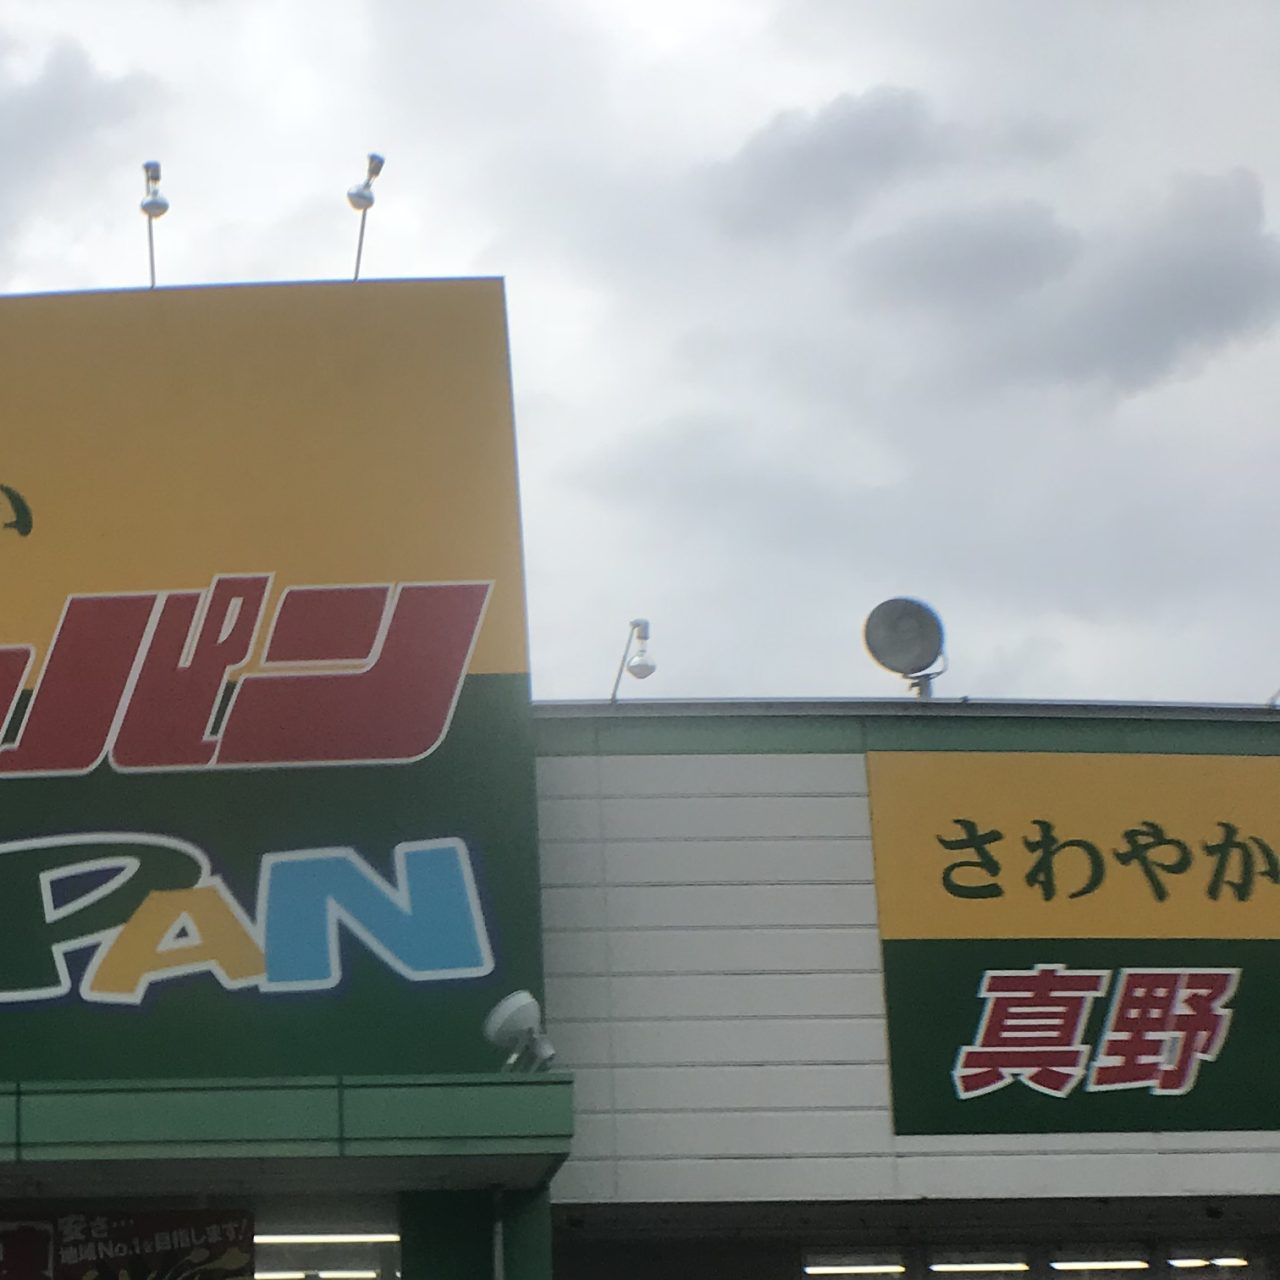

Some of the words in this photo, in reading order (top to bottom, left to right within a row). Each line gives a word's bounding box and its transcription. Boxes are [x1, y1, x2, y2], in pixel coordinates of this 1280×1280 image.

[935, 818, 1280, 902] さわやか
[951, 963, 1243, 1100] 真野
